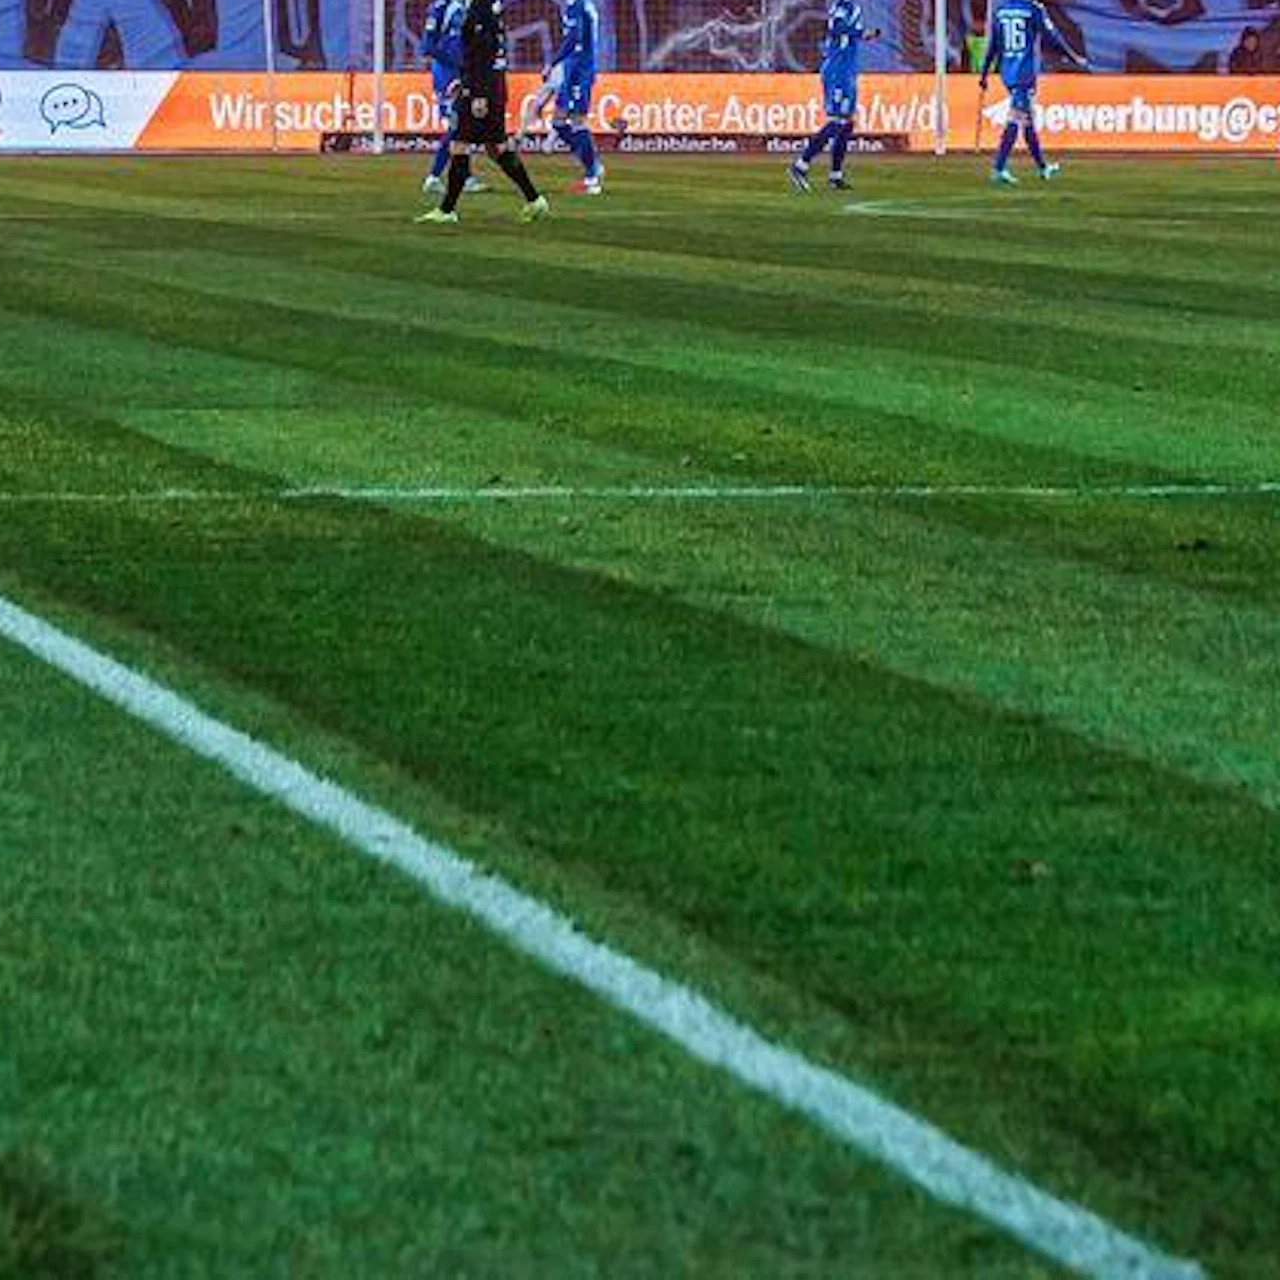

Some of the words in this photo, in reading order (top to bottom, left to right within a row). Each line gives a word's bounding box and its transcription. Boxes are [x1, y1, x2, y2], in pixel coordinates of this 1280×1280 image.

[998, 17, 1027, 51] 16
[209, 93, 266, 131] Wir
[274, 92, 397, 131] suchen
